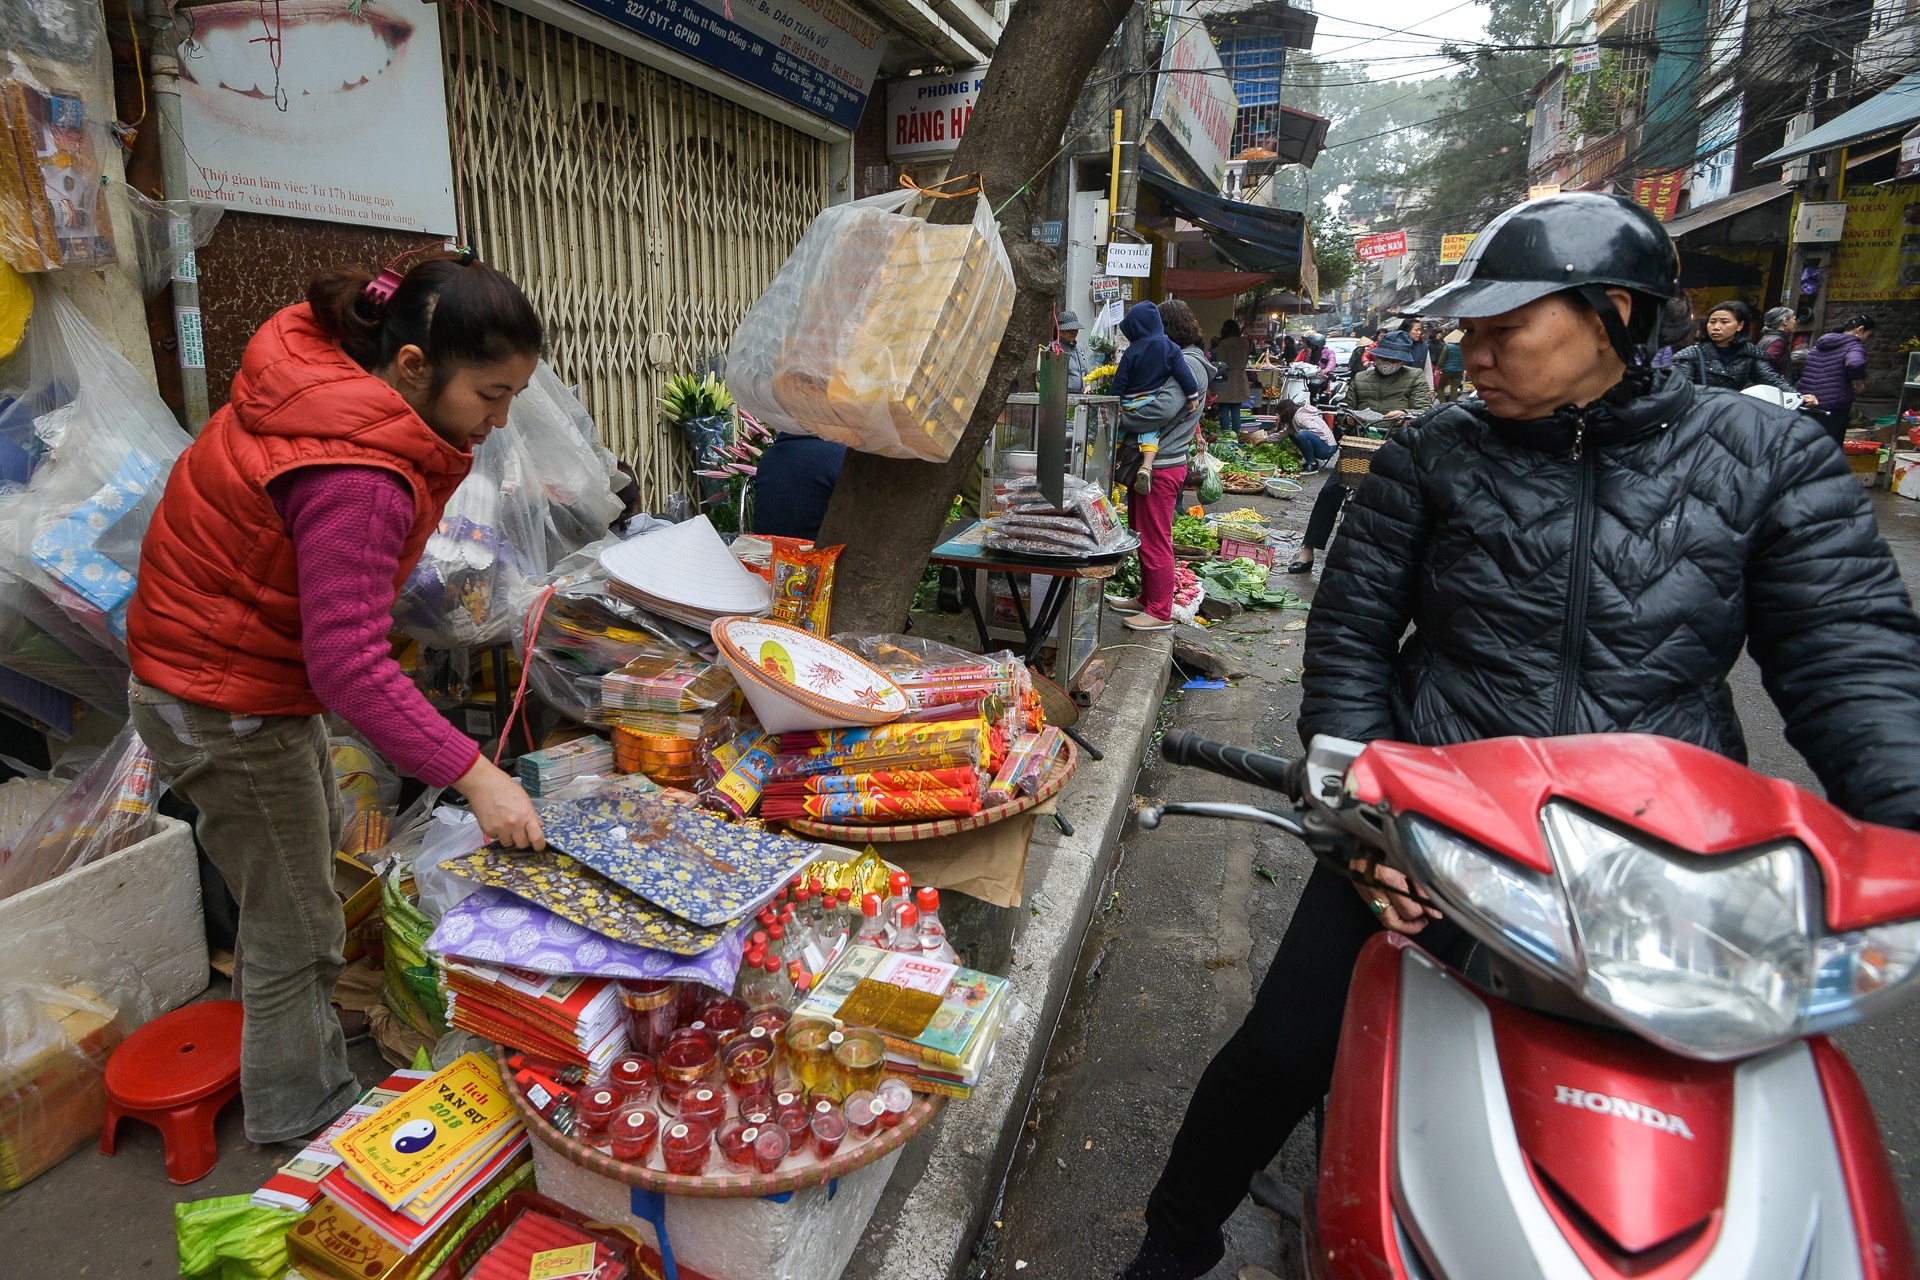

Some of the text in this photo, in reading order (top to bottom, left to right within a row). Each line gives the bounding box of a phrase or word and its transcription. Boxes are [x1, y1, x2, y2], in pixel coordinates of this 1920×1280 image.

[648, 10, 670, 31] SYT
[666, 0, 677, 12] 18
[683, 6, 699, 24] Khu
[709, 20, 727, 39] Nam
[727, 29, 747, 51] Đồng
[751, 42, 764, 57] HN
[758, 2, 771, 16] Bs.
[794, 20, 816, 41] TUẤN
[814, 72, 825, 84] 17h
[918, 81, 969, 99] PHÒNG
[896, 98, 973, 145] RĂNG HÀ
[201, 167, 395, 208] Thời gian làm việc: Từ 17h hàng ngày
[189, 185, 212, 200] êng
[215, 189, 235, 202] thứ
[239, 191, 245, 203] 7
[249, 194, 262, 206] và
[265, 195, 285, 208] chủ
[288, 196, 311, 214] nhật
[315, 201, 326, 213] có
[328, 203, 356, 218] khám
[358, 207, 369, 219] cả
[371, 207, 391, 222] buổi
[1109, 247, 1150, 256] CHO THUÊ
[1360, 244, 1373, 256] CẮT
[1374, 241, 1387, 254] TÓC
[1388, 240, 1403, 252] NAM
[1107, 260, 1149, 270] CỬA HÀNG
[438, 1083, 488, 1125] VẠN SỰ
[462, 1081, 489, 1106] lịch
[428, 1102, 464, 1129] 2018
[1554, 1084, 1695, 1140] HONDA
[365, 1146, 381, 1161] Mậu
